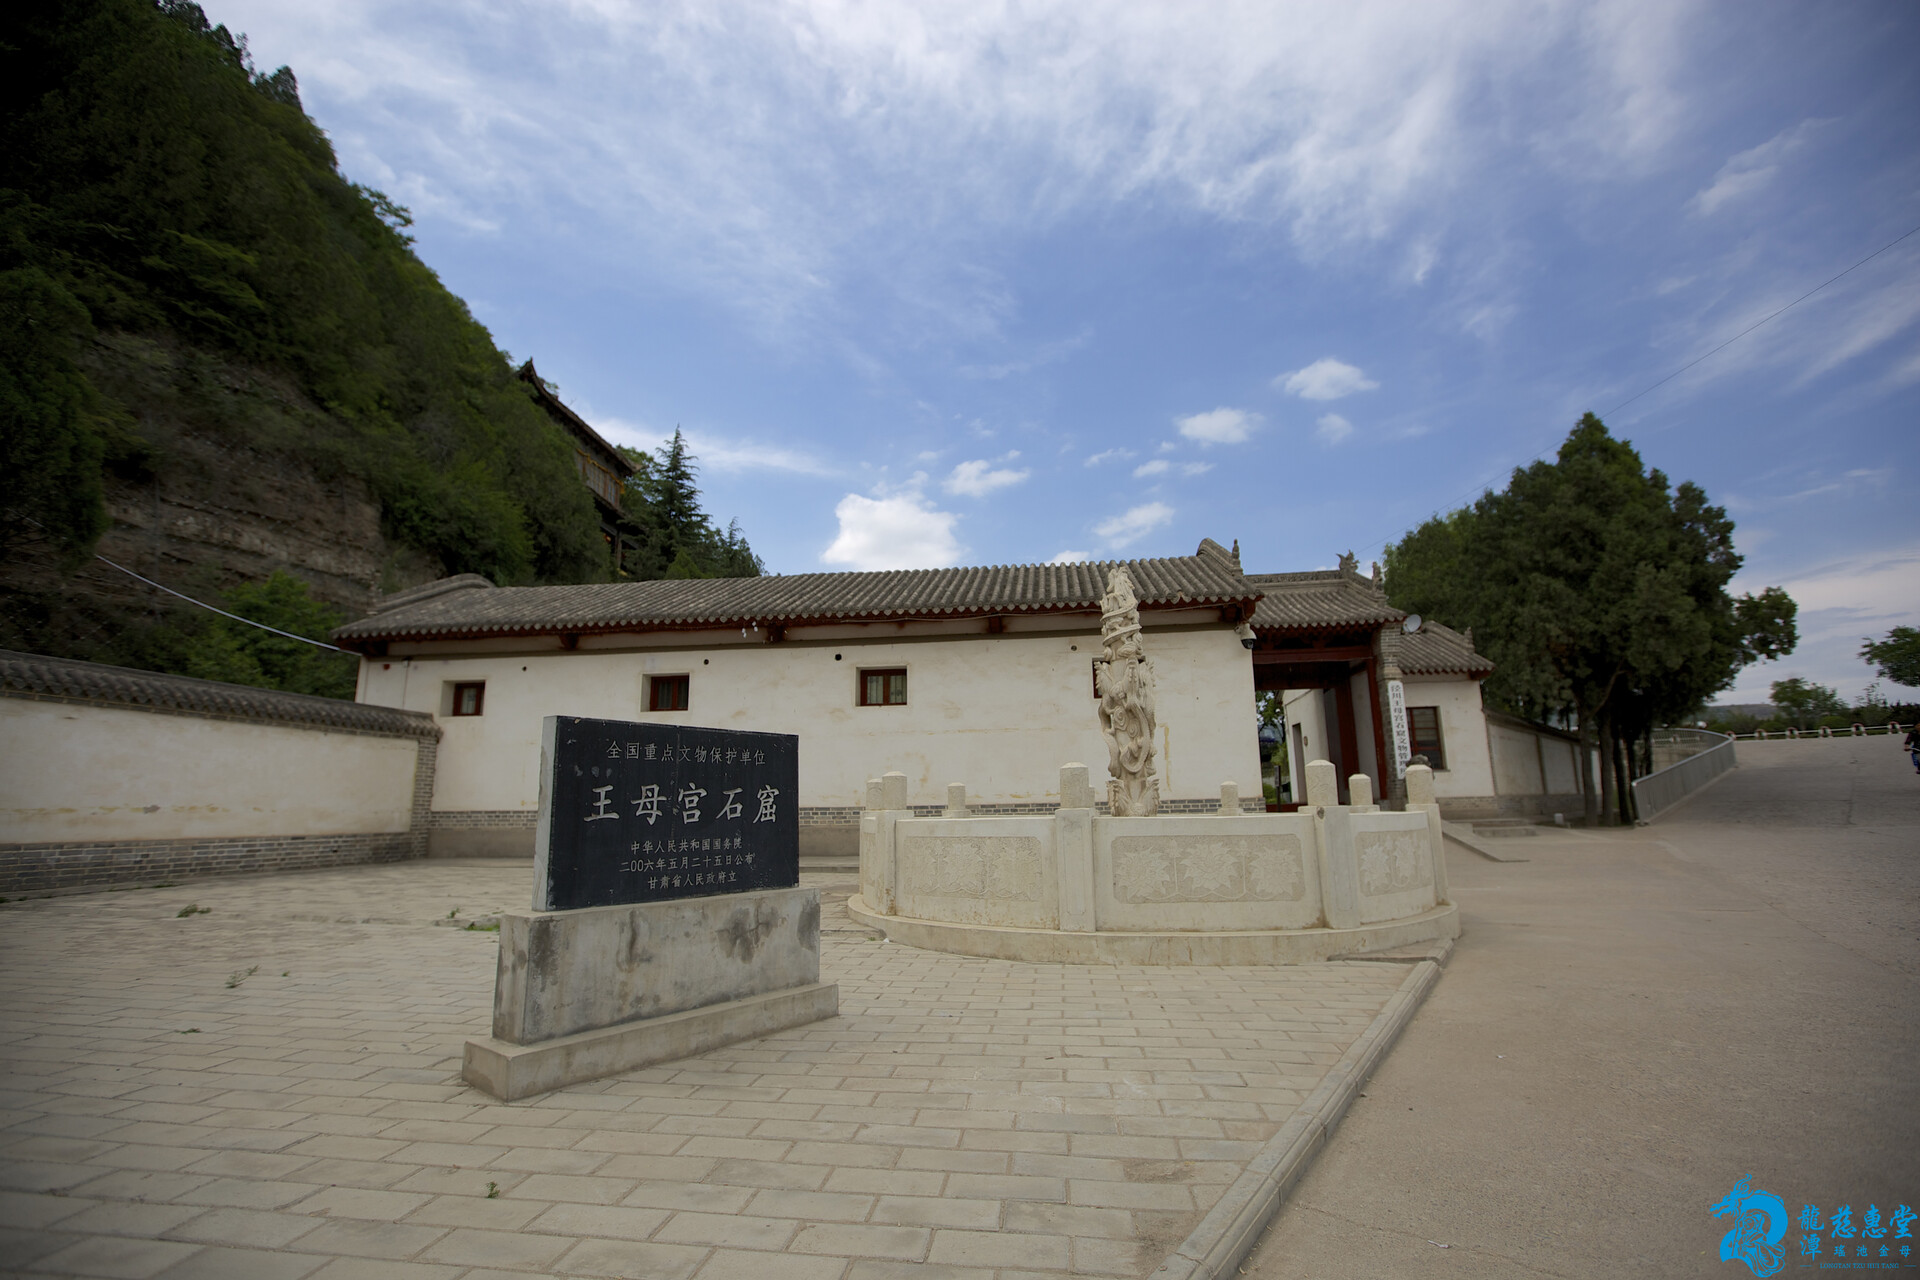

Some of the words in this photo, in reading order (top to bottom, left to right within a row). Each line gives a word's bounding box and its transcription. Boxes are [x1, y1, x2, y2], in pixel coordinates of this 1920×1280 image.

[606, 740, 767, 766] 全国重点文物保护单位
[583, 782, 781, 826] 王母宫石窟
[630, 837, 743, 856] 中华人民共和国国务院
[647, 871, 738, 890] 甘肃省人民政府立
